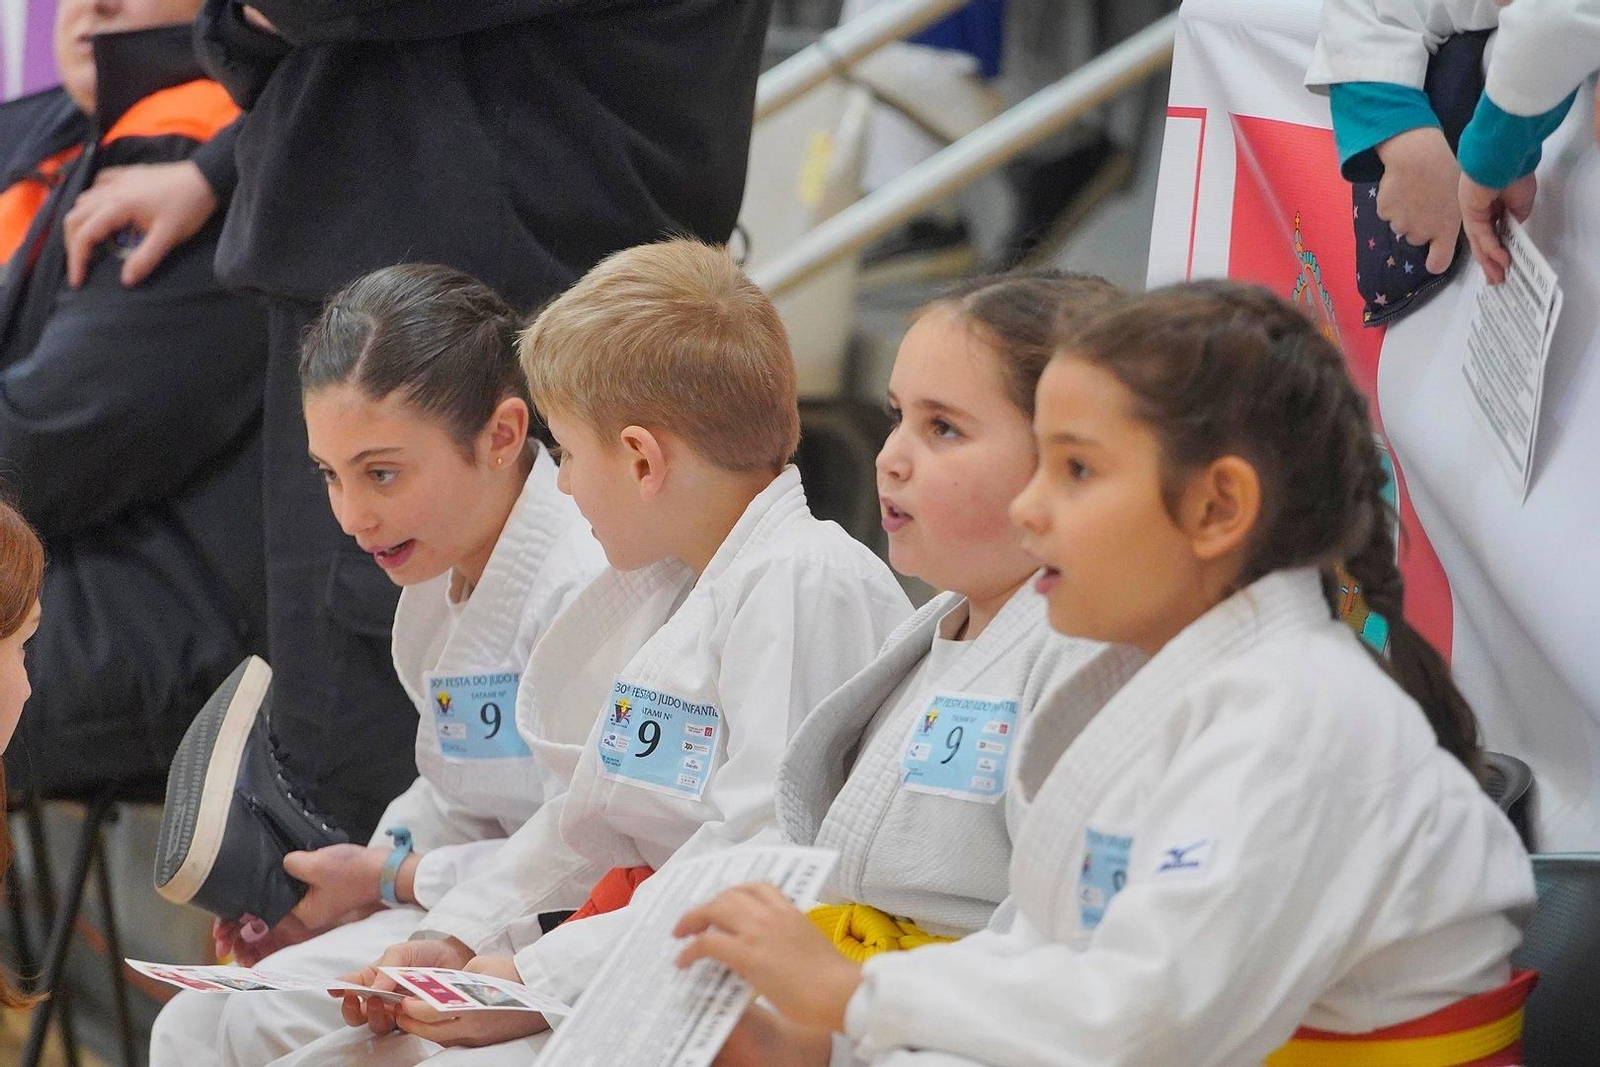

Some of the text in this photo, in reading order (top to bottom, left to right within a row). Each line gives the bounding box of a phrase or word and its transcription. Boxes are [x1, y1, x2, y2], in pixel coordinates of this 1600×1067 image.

[445, 676, 470, 687] FESTA
[473, 675, 487, 686] DO
[490, 672, 512, 686] JUDO
[657, 693, 681, 708] JUDO
[480, 702, 502, 739] 9
[635, 720, 661, 757] 9
[941, 726, 964, 765] 9
